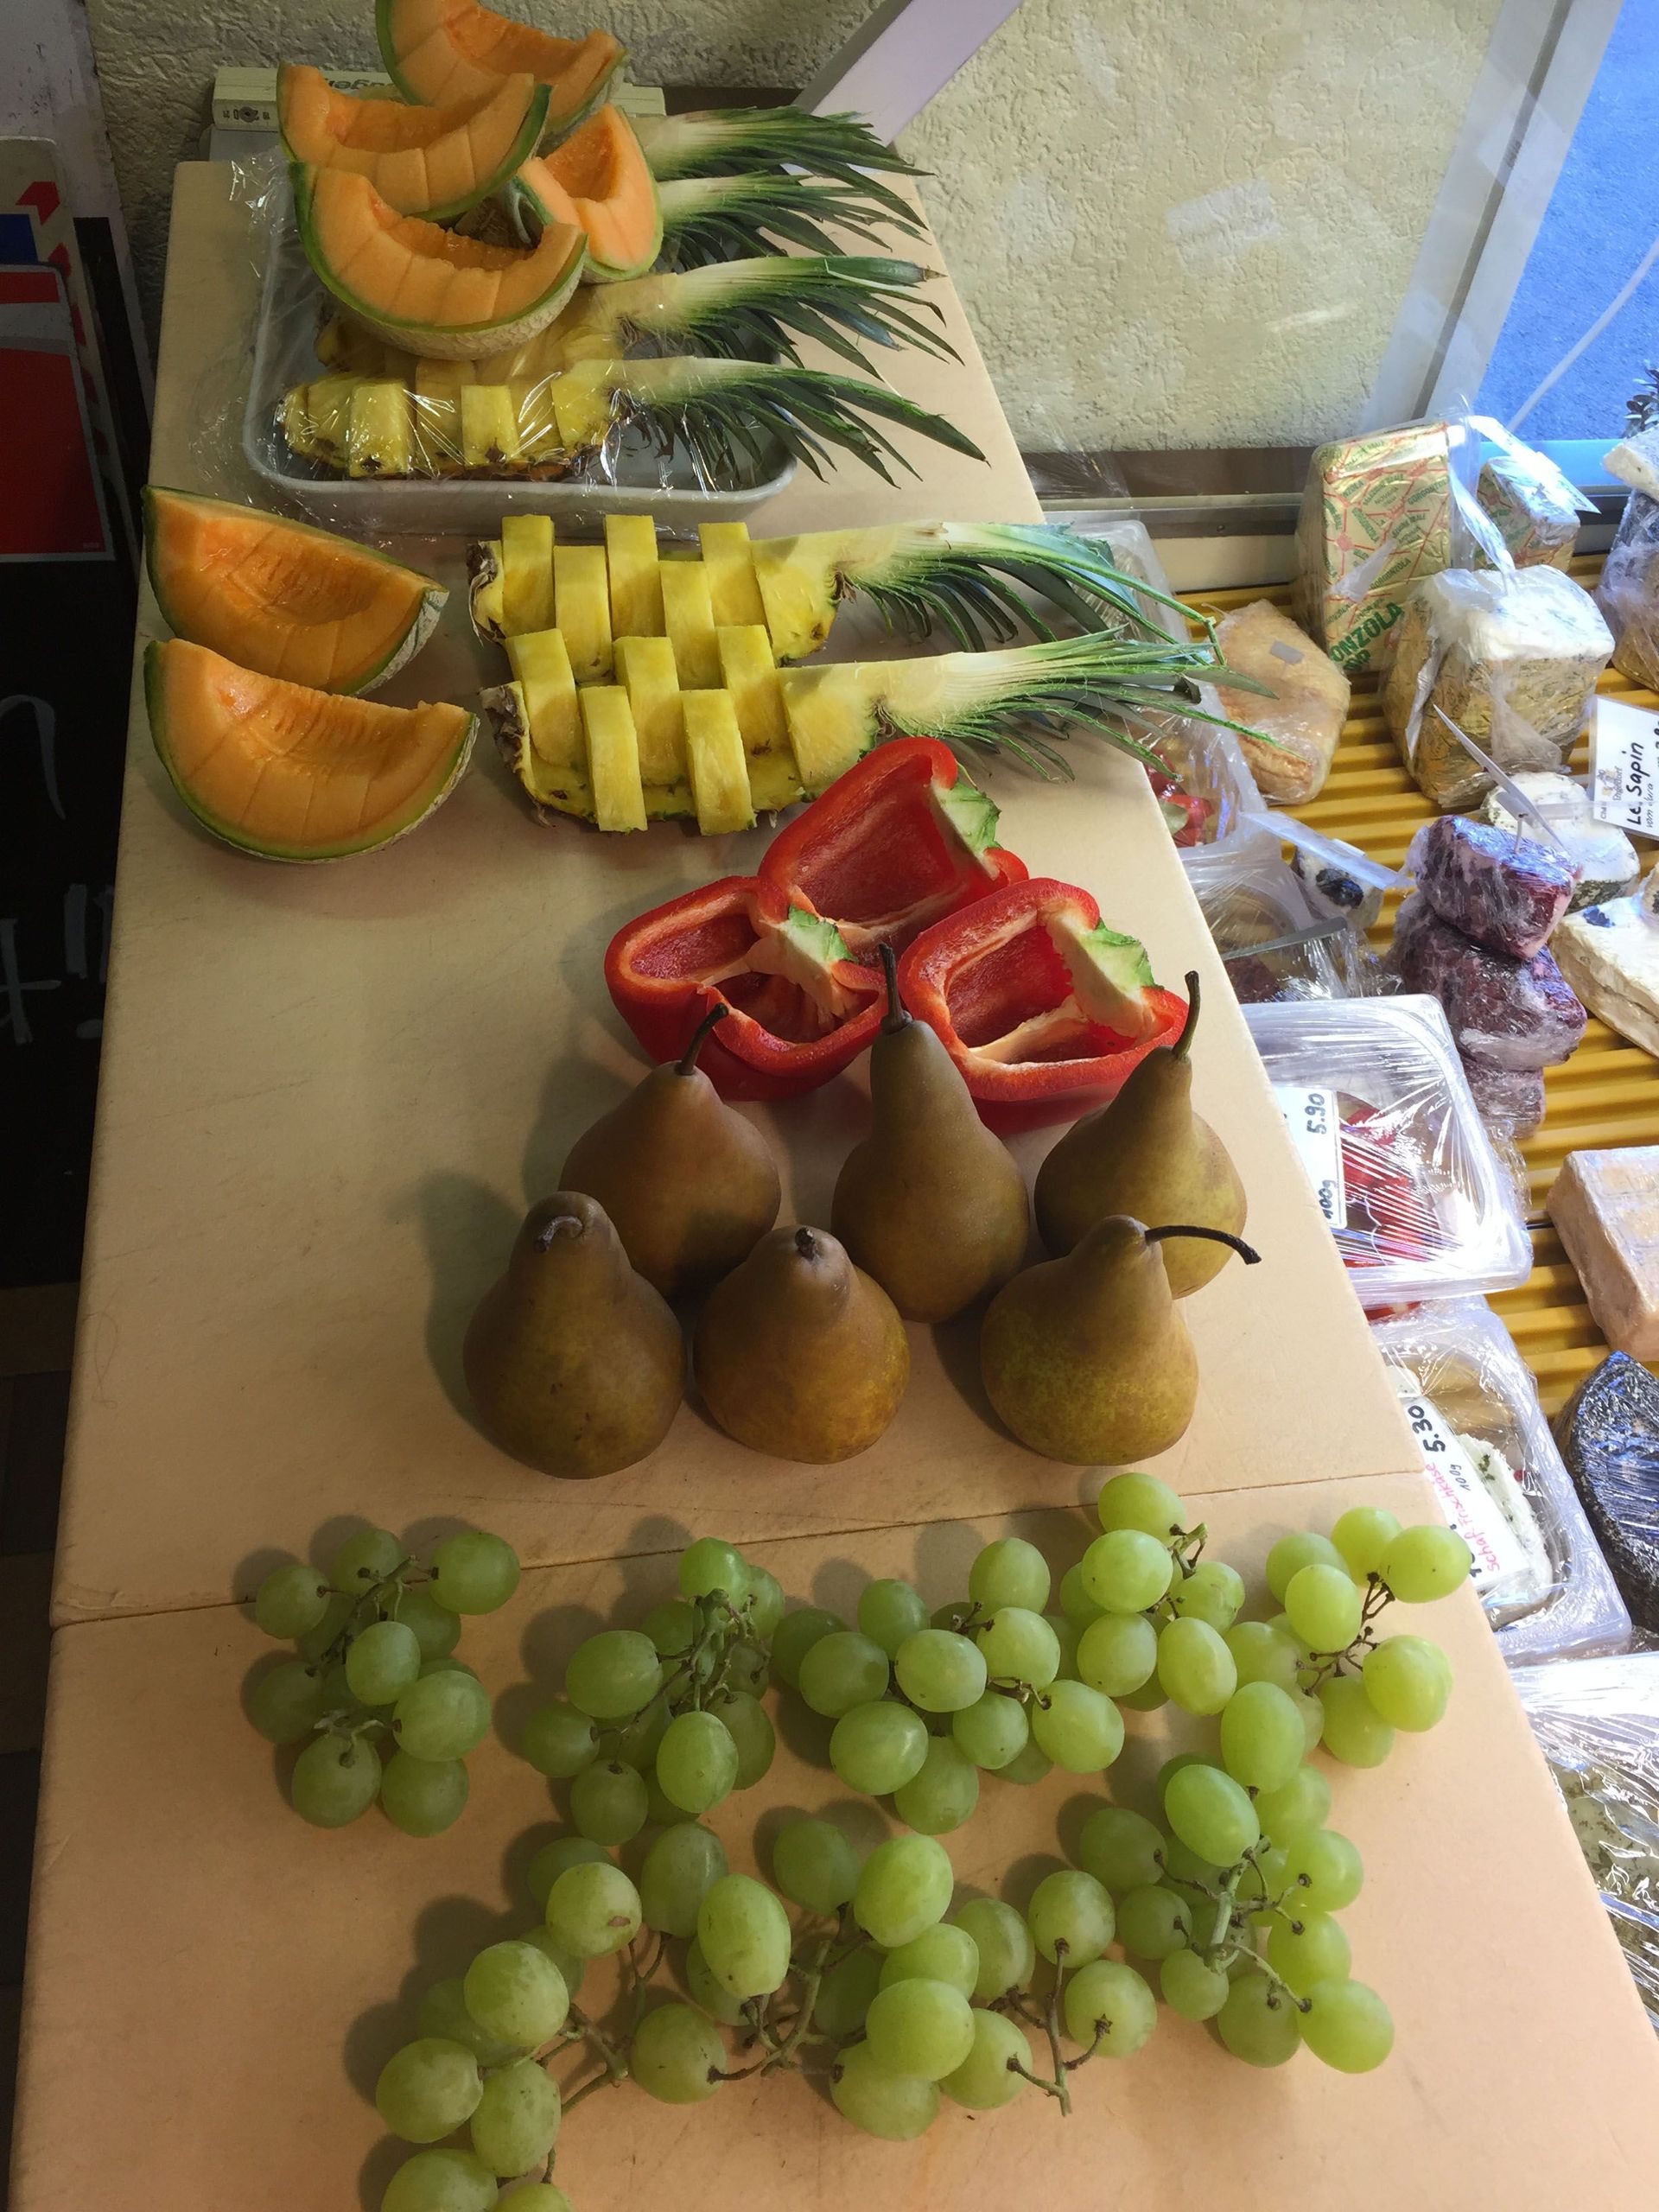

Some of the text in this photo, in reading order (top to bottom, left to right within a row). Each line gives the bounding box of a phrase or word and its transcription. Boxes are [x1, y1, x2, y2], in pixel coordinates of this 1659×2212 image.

[1622, 741, 1651, 797] Sapin
[1304, 1093, 1327, 1135] 5.90
[1408, 1404, 1446, 1452] 5.30
[1450, 1464, 1471, 1491] 100g
